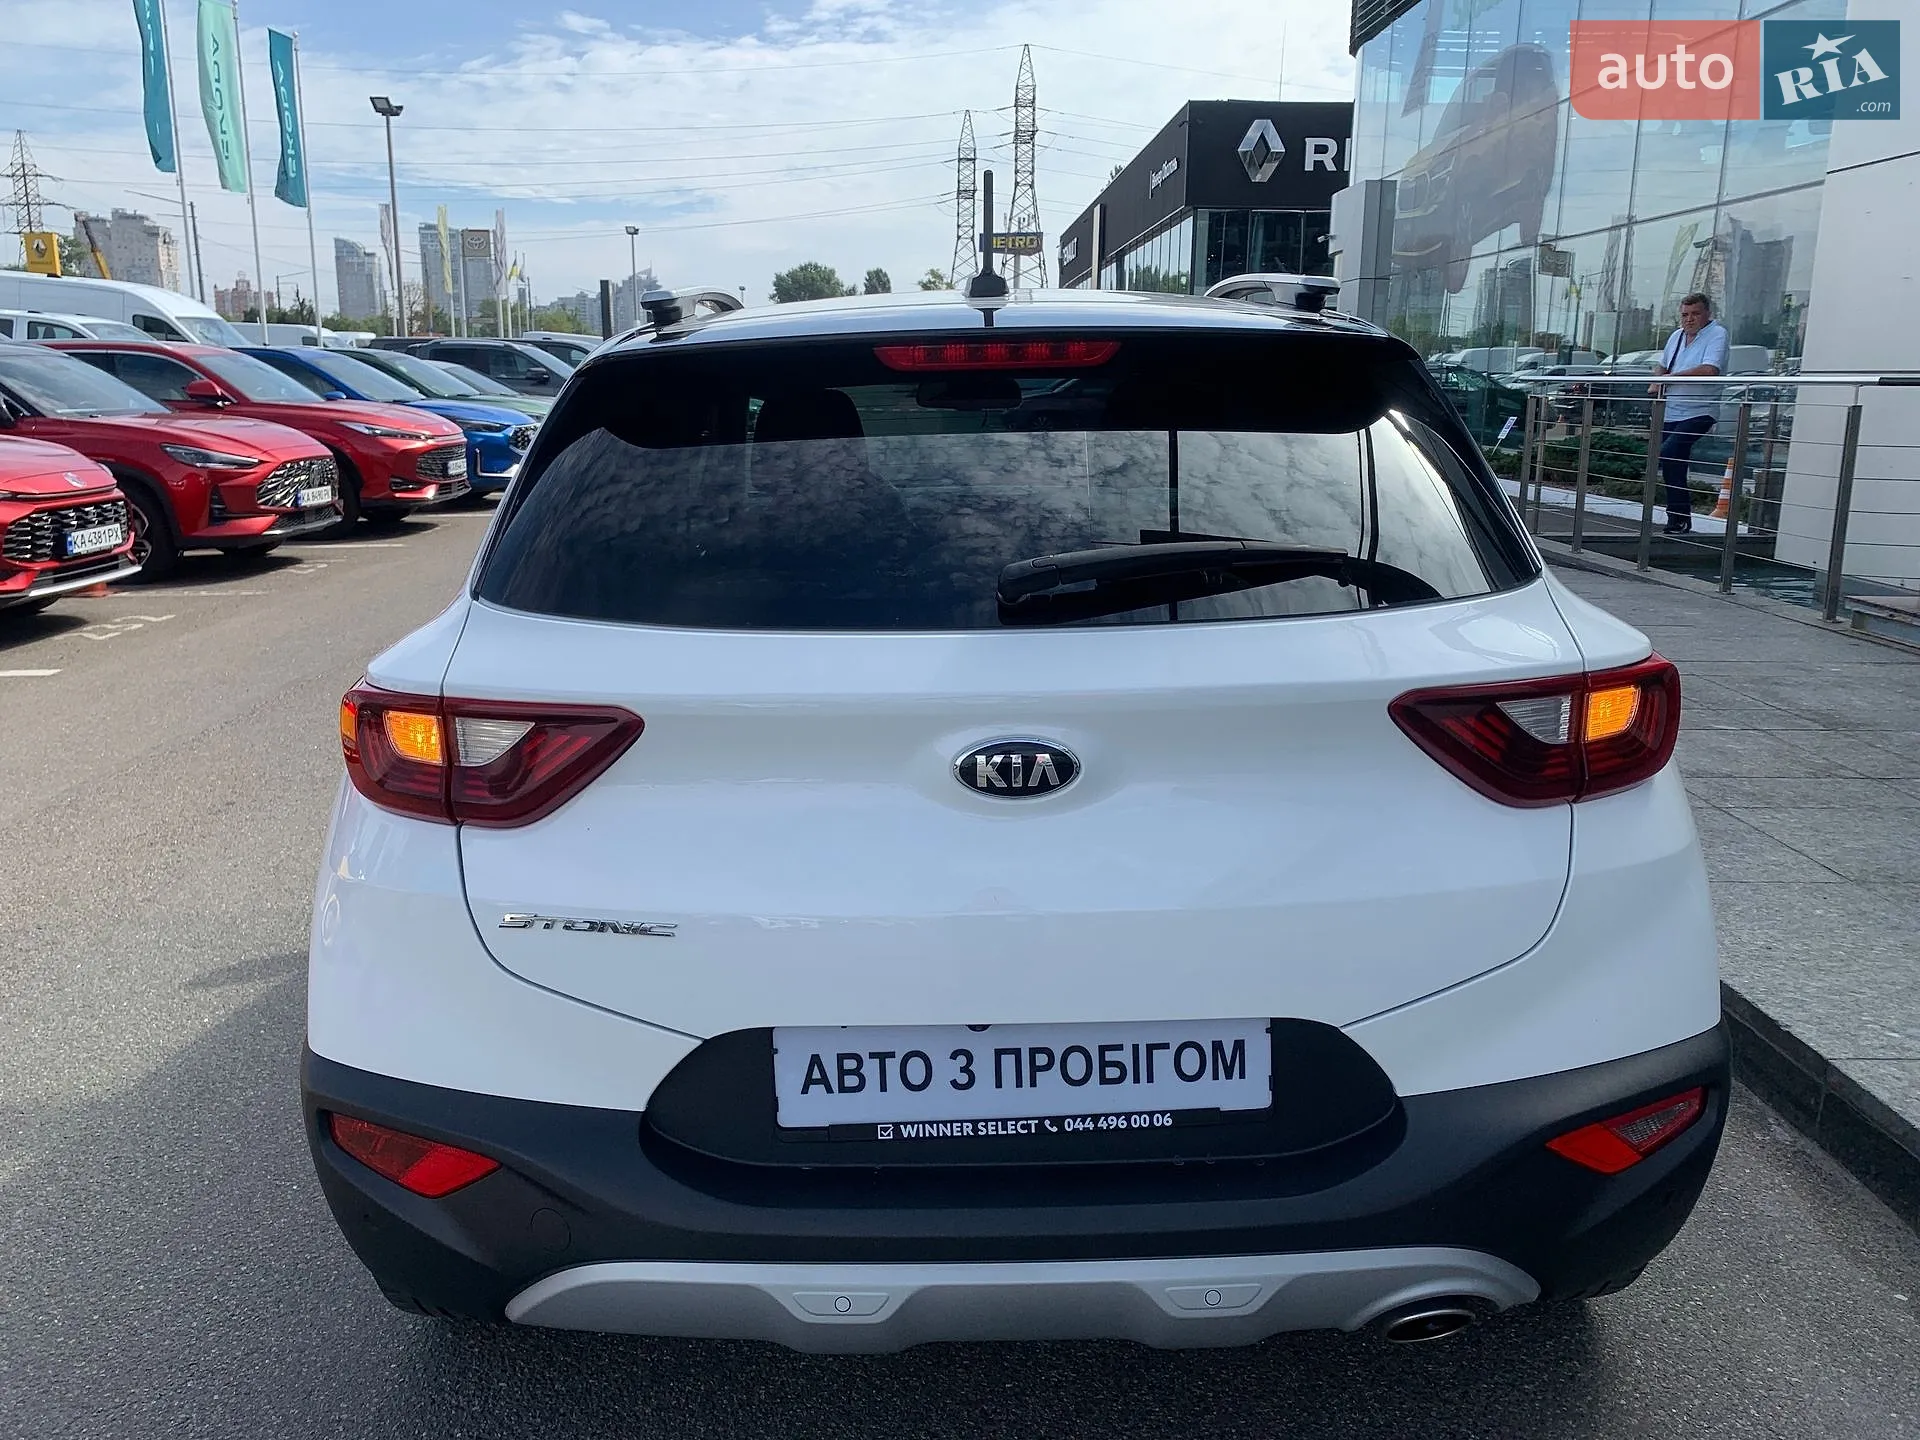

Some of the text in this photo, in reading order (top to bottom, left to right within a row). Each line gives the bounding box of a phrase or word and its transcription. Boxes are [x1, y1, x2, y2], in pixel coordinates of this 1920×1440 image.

[975, 753, 1060, 788] KIA
[499, 912, 678, 938] STONIC
[800, 1039, 1248, 1095] АВТО З ПРОБІГОМ
[900, 1112, 1173, 1138] WINNER SELECT 044 496 00 06
